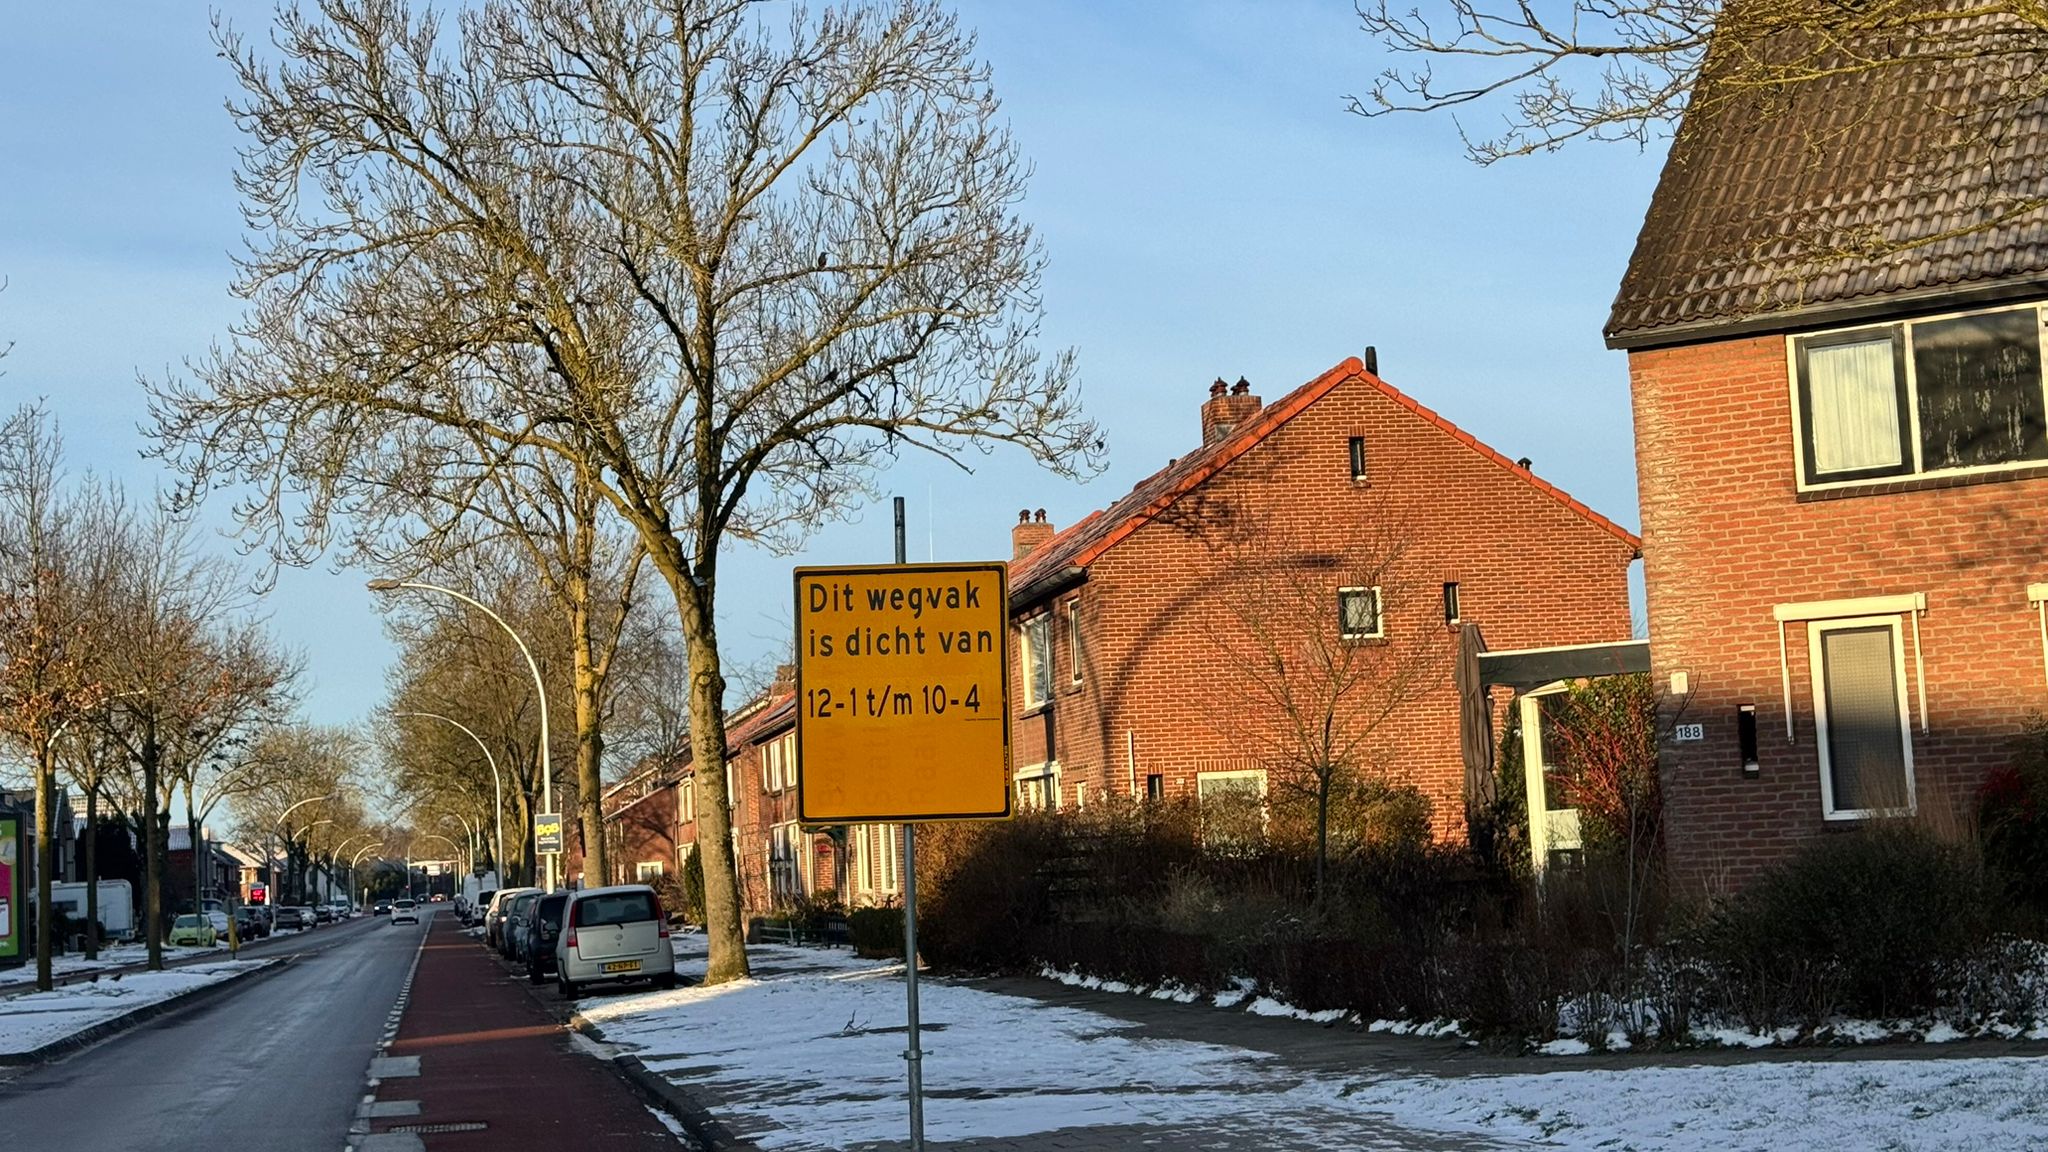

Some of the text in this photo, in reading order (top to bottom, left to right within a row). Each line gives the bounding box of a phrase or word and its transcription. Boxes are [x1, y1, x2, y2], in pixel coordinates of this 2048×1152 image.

[810, 580, 980, 619] Dit wegvak
[809, 625, 993, 657] is dicht van
[808, 684, 981, 718] 12-1 t/m 10-4
[1678, 727, 1700, 738] 188
